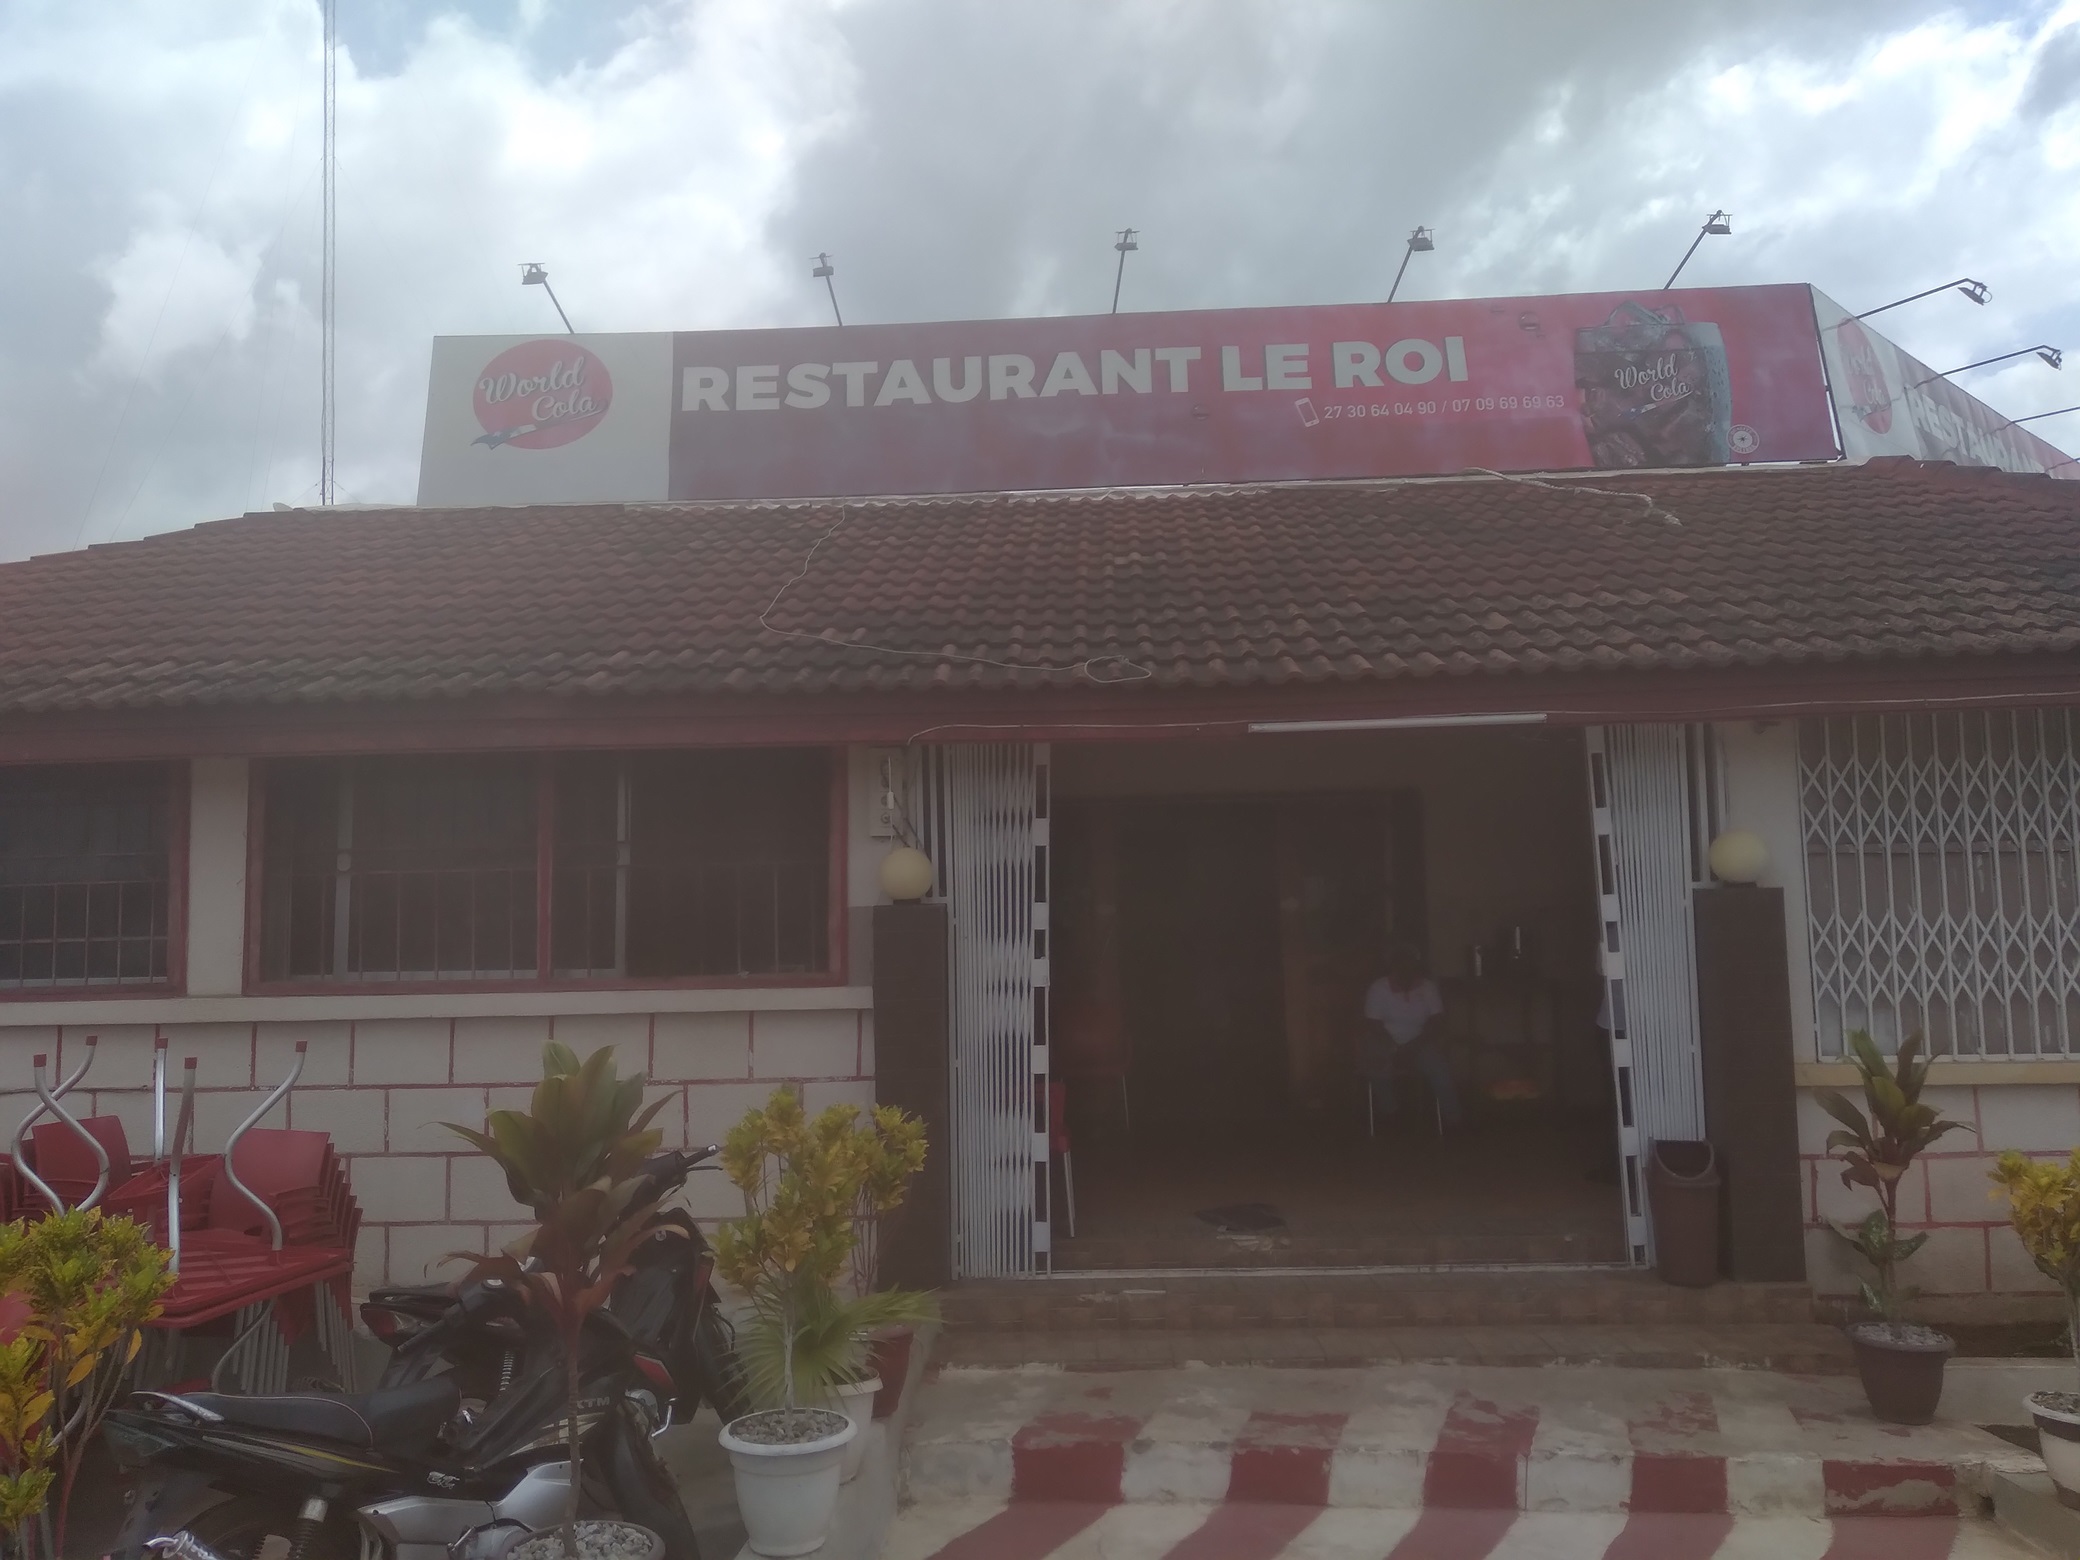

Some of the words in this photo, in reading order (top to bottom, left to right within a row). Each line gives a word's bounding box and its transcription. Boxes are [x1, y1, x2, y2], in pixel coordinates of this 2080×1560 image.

[479, 356, 585, 404] World
[681, 346, 1201, 412] RESTAURANT
[1222, 343, 1312, 391] LE
[1333, 336, 1469, 388] ROI
[1614, 354, 1678, 389] World
[531, 389, 598, 422] Cola
[1650, 377, 1691, 401] Cola
[1324, 406, 1343, 419] 27
[1347, 404, 1366, 417] 30
[1370, 403, 1390, 416] 64
[1394, 402, 1414, 415] 04
[1418, 401, 1437, 414] 90
[1441, 401, 1447, 413] /
[1452, 399, 1471, 412] 07
[1475, 398, 1495, 411] 09
[1499, 396, 1518, 409] 69
[1522, 396, 1542, 408] 69
[1546, 395, 1565, 408] 63
